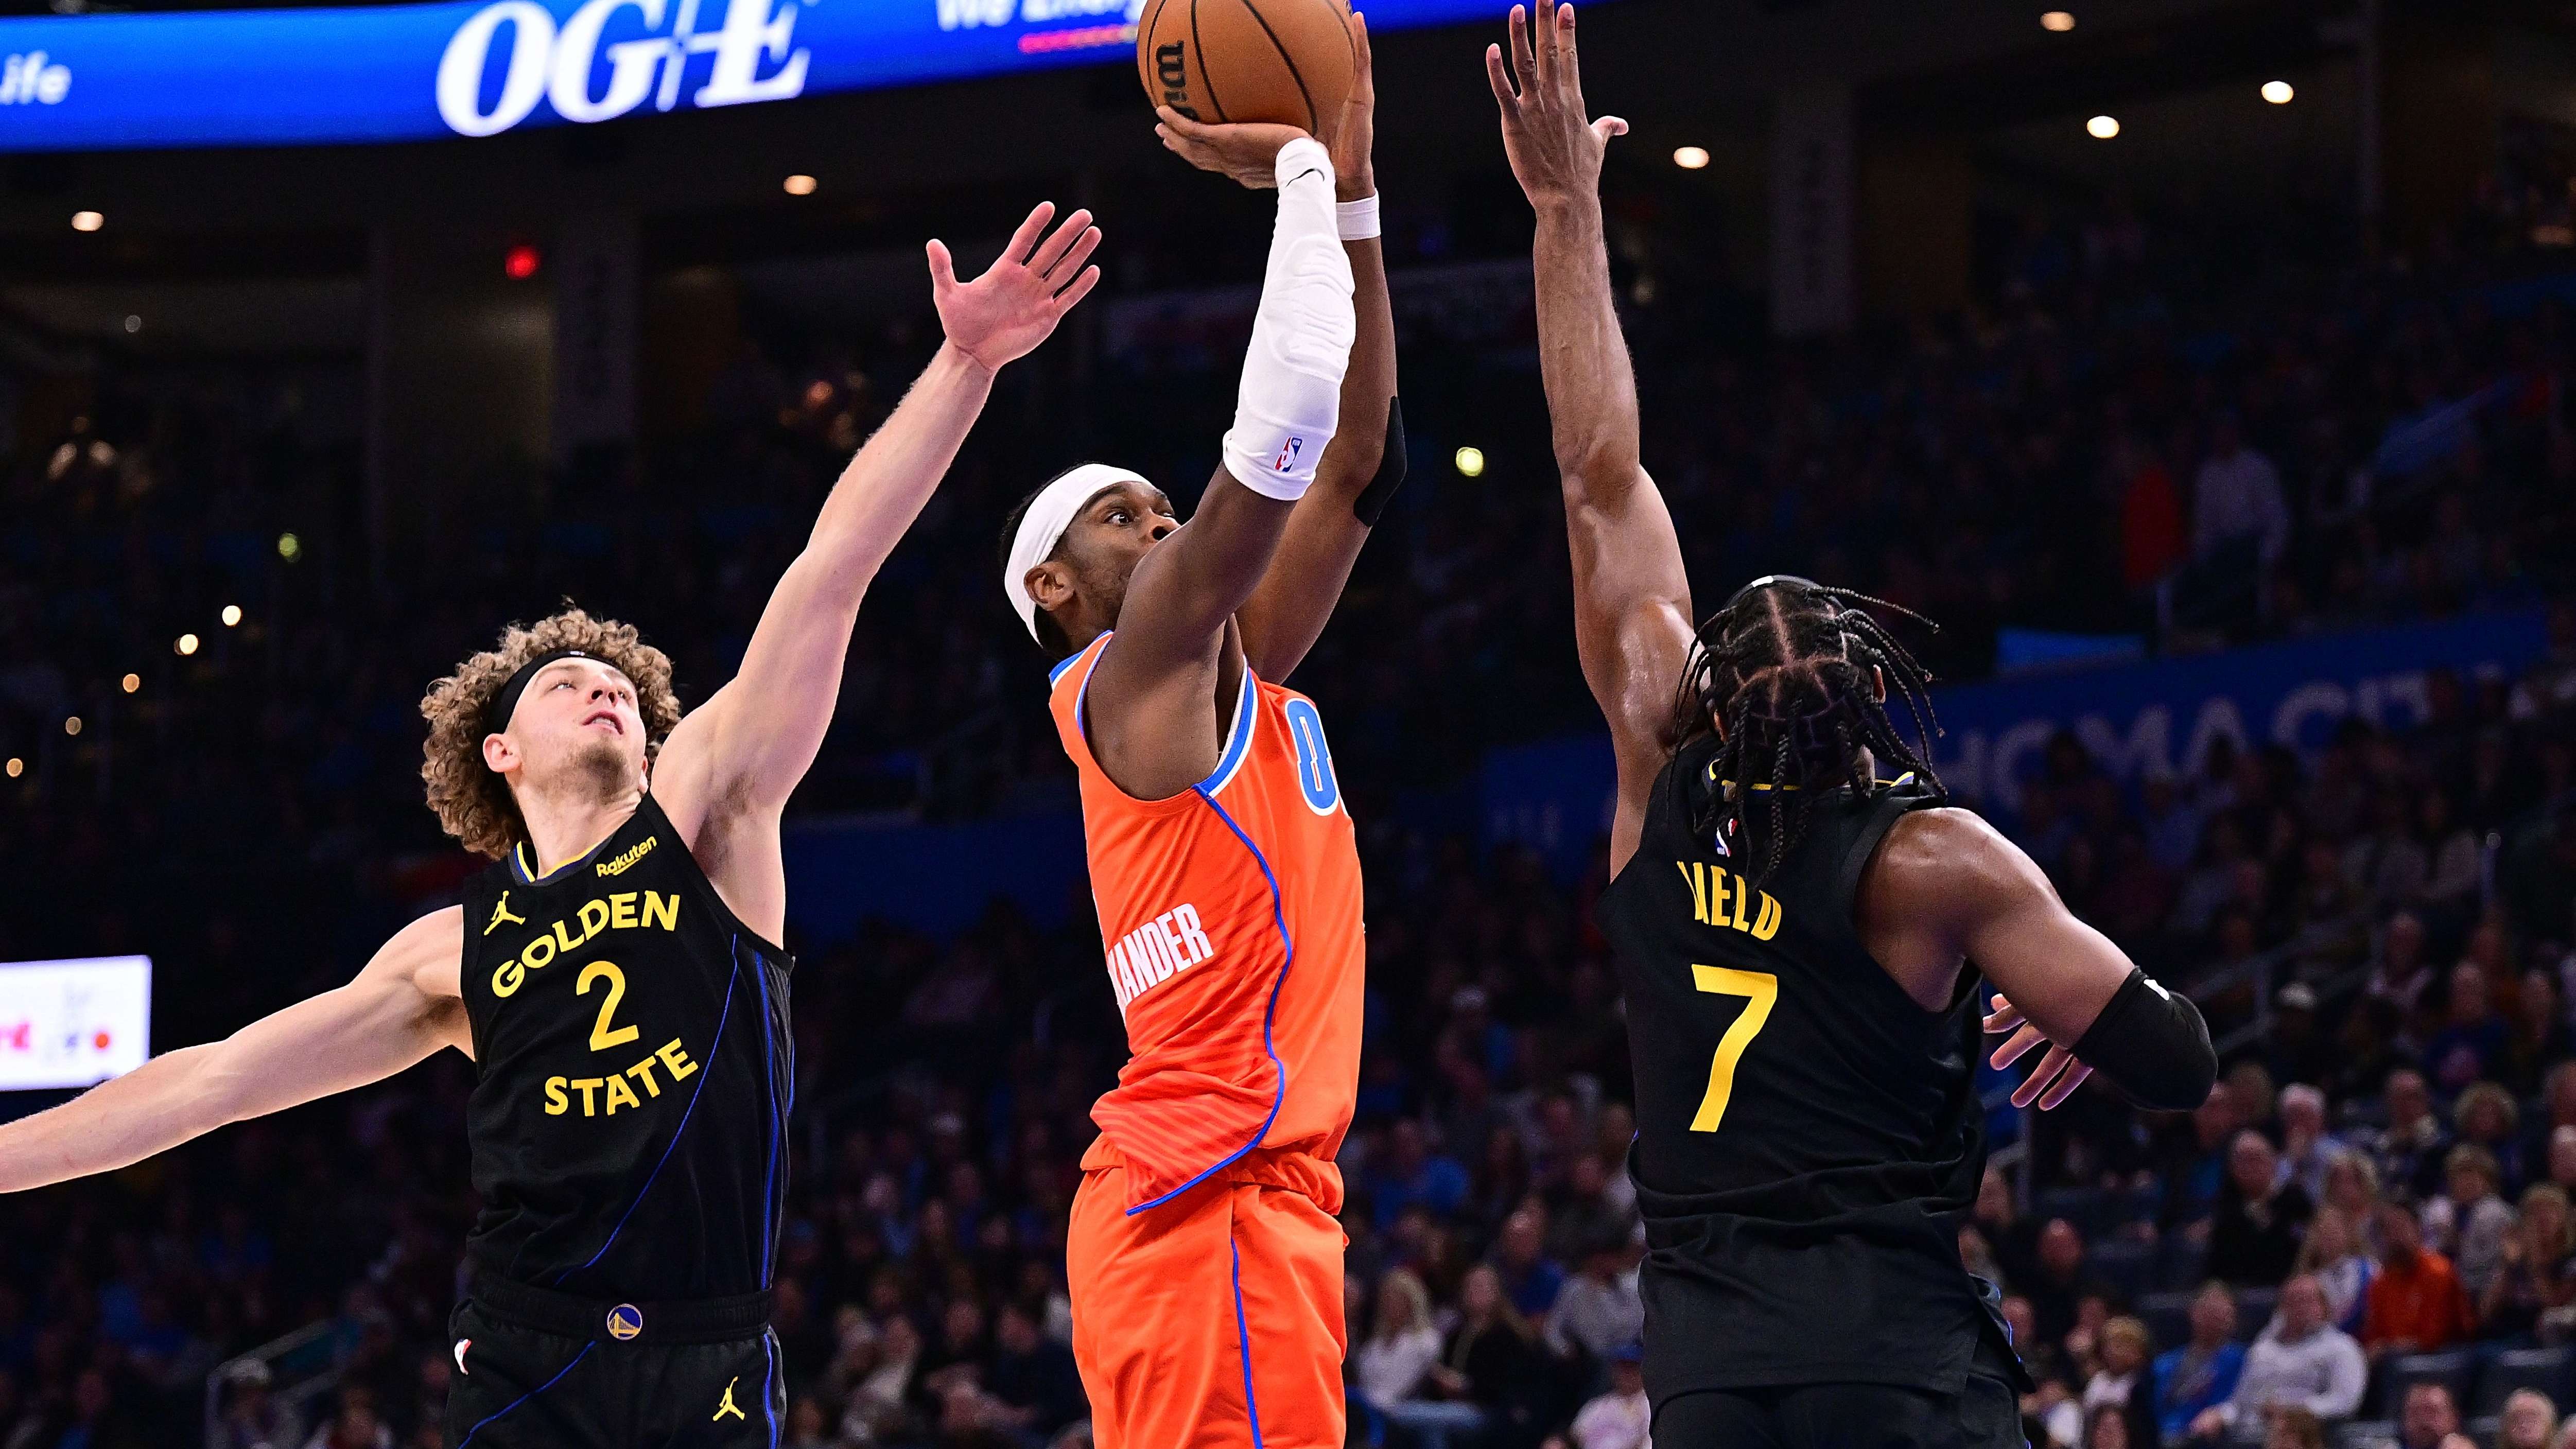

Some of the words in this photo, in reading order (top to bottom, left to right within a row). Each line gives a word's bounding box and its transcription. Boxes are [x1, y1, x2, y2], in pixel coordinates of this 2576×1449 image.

[596, 836, 657, 877] Rakuten
[492, 891, 680, 998] GOLDEN
[576, 961, 639, 1052] 2
[1690, 964, 1778, 1132] 7
[545, 1038, 699, 1117] STATE
